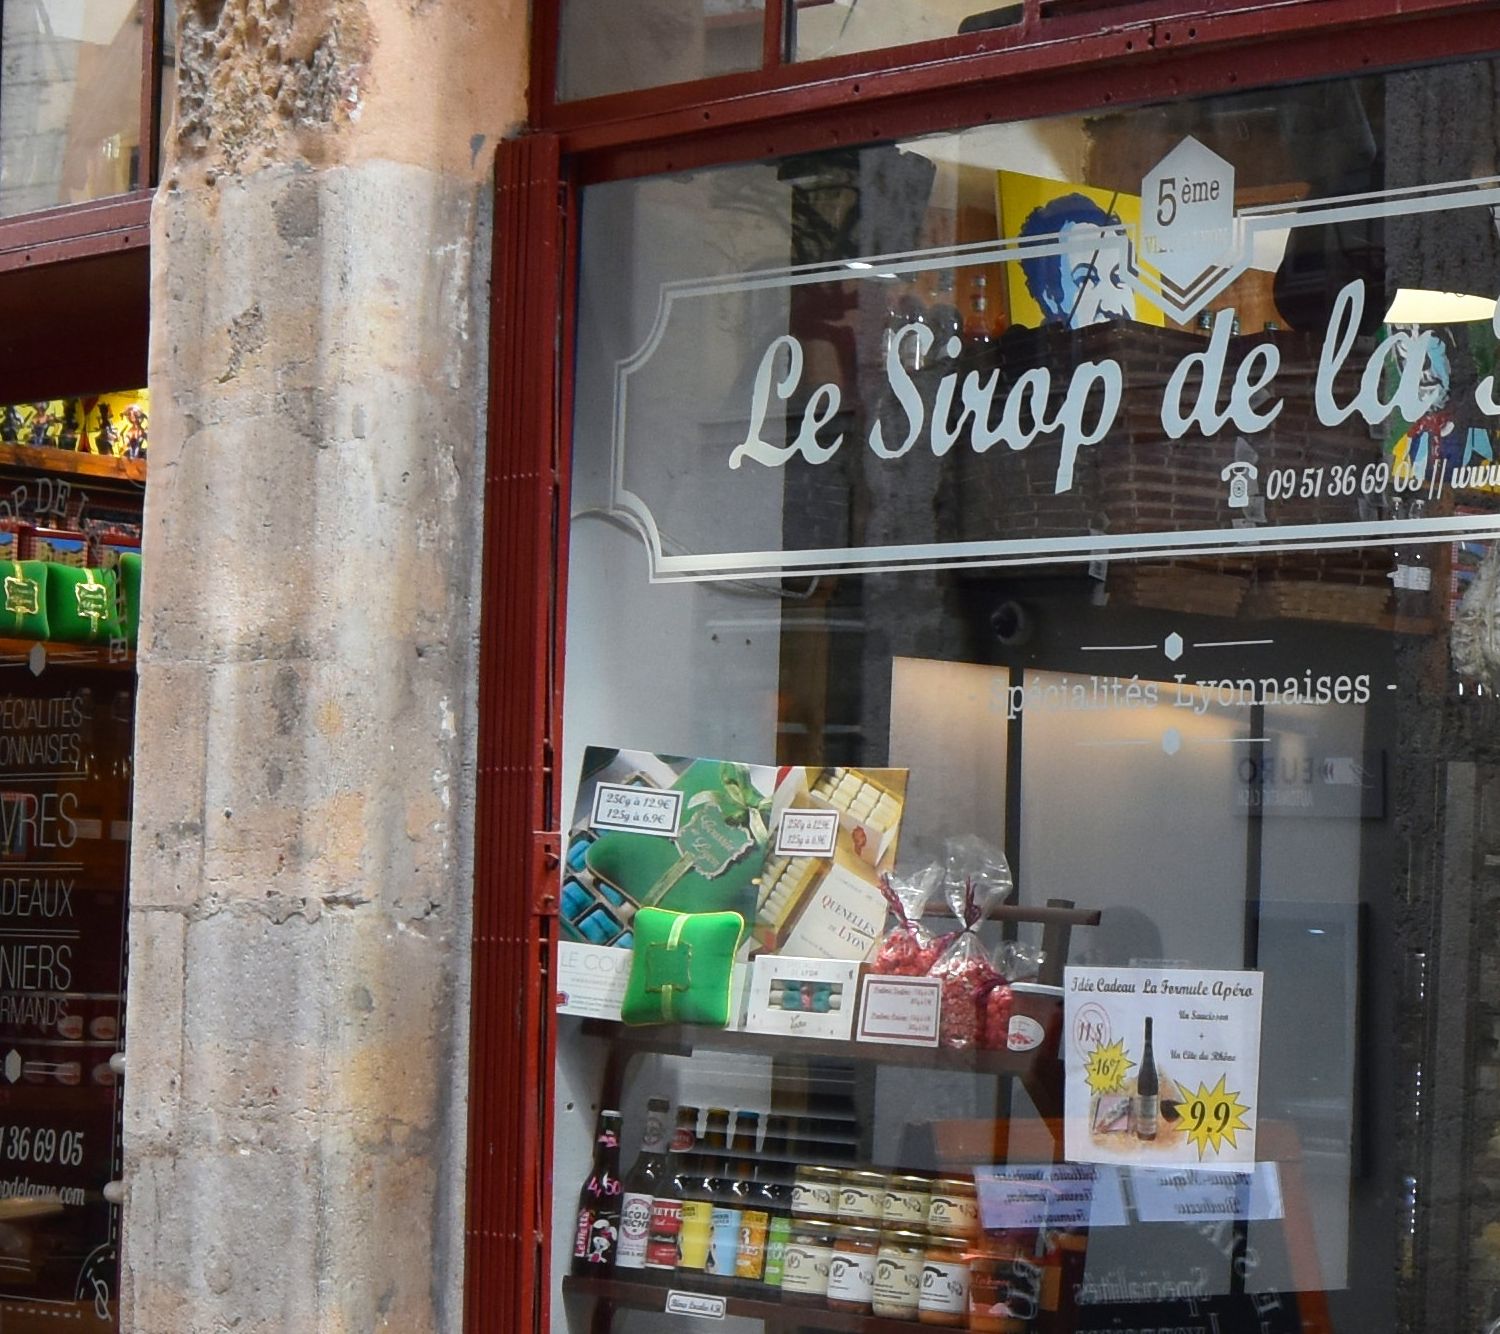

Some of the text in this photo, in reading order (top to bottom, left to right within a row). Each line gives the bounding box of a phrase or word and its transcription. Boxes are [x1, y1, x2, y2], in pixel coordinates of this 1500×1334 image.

[729, 333, 844, 470] Le
[869, 321, 1123, 495] Sirop
[1164, 307, 1284, 440] de
[1314, 277, 1445, 428] la
[34, 477, 71, 517] DE
[1266, 469, 1297, 500] 09
[1300, 468, 1324, 499] 51
[1328, 466, 1357, 497] 36
[1359, 464, 1389, 495] 69
[988, 669, 1371, 719] Spécialités Lyonnaises
[584, 953, 631, 975] COU
[1071, 976, 1254, 1001] Idée Cadeau La Formule Apéro
[1190, 1100, 1230, 1134] 9.9
[7, 1125, 31, 1161] 36
[33, 1127, 57, 1163] 69
[59, 1130, 85, 1166] 05
